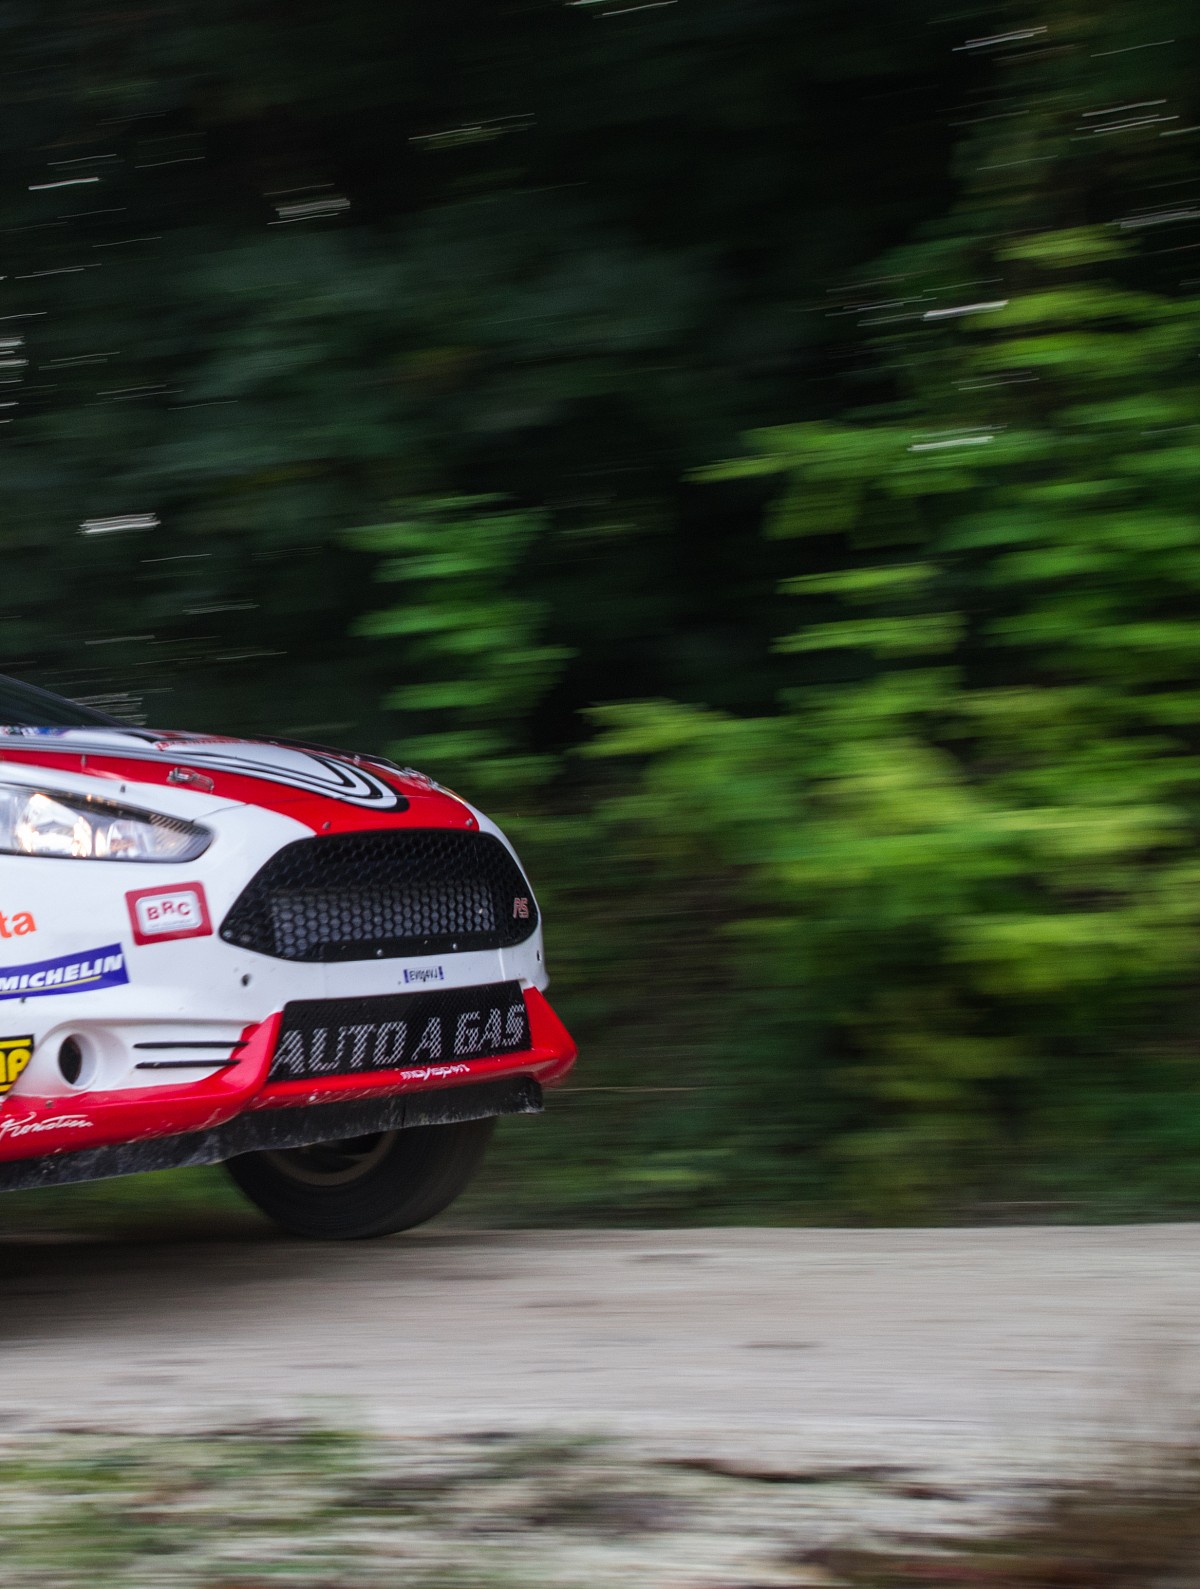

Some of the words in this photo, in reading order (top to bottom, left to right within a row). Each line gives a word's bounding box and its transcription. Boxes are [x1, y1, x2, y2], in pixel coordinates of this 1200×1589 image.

[146, 901, 191, 921] BRC
[267, 1021, 408, 1077] AUTO
[411, 1016, 442, 1061] A
[452, 1003, 526, 1056] GAS
